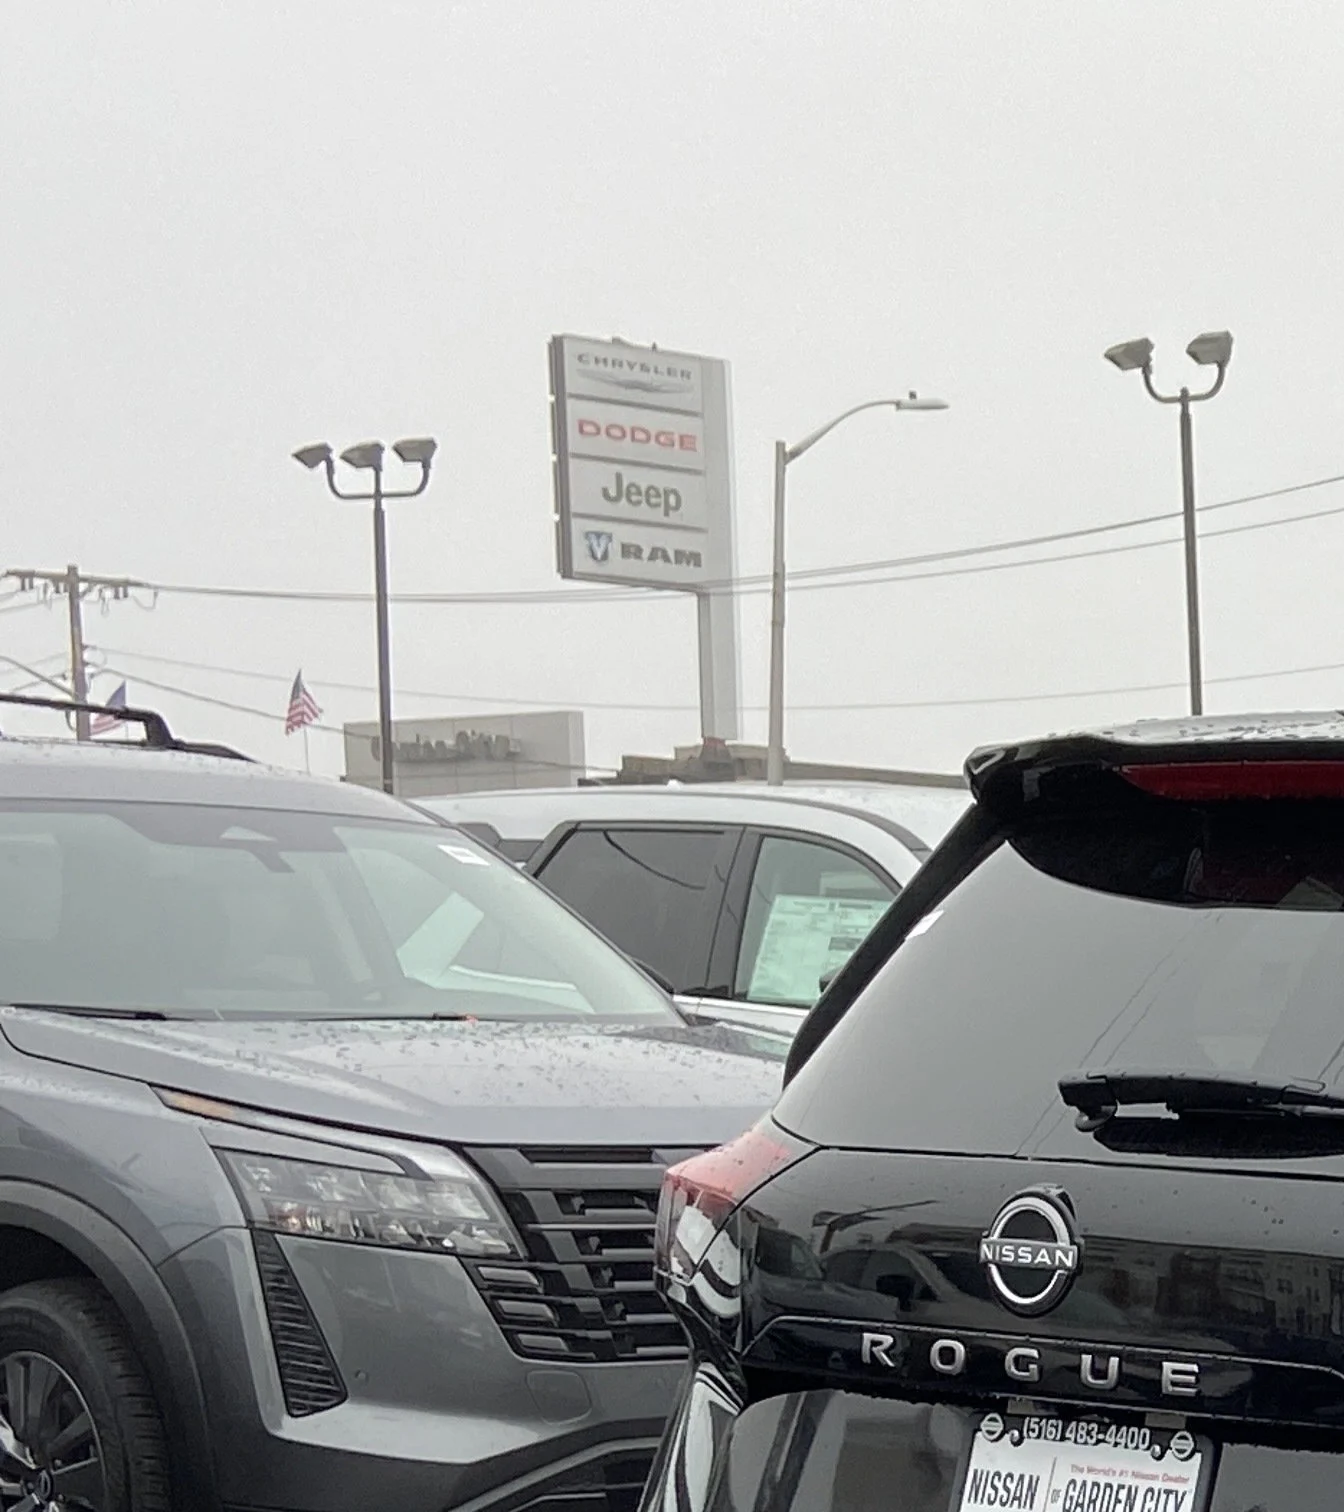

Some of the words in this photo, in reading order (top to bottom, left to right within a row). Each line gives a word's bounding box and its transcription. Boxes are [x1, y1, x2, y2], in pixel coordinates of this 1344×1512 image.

[577, 353, 693, 381] CHRYSLER
[577, 418, 698, 452] DODGE
[601, 471, 682, 517] Jeep
[620, 541, 703, 568] RAM
[980, 1244, 1075, 1268] NISSAN
[860, 1332, 1200, 1396] ROGUE
[1023, 1416, 1063, 1440] (516)
[1065, 1421, 1151, 1450] 483-4400
[967, 1468, 1040, 1511] NISSAN
